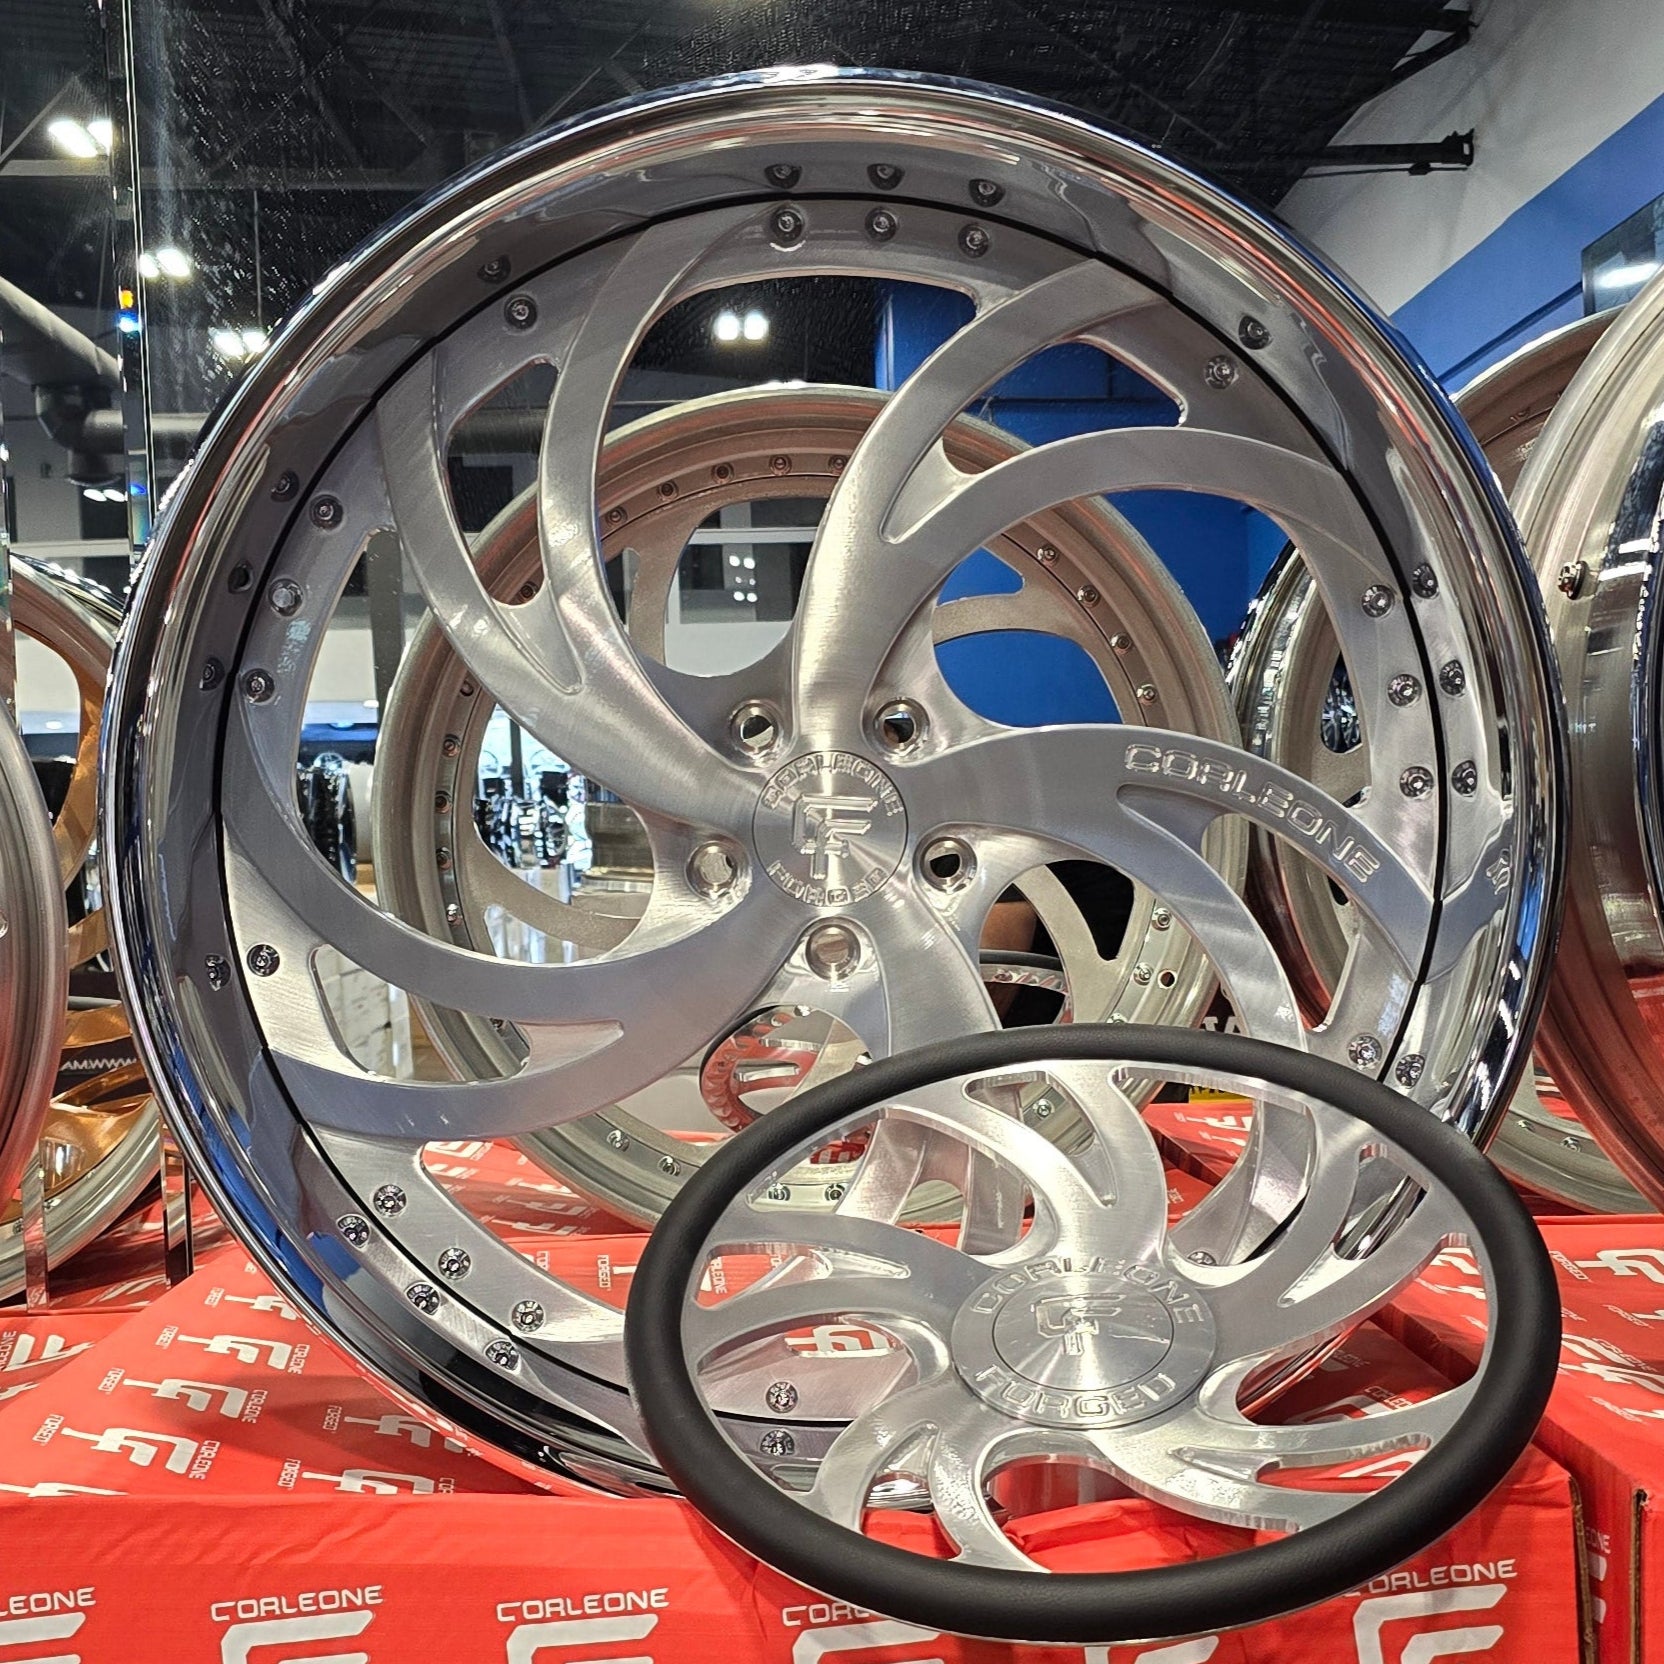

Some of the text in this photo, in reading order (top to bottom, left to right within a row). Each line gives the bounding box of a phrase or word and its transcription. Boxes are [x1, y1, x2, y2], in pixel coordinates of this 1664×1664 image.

[760, 753, 904, 816] CORLEONE
[1124, 743, 1380, 884] CORLEONE
[767, 859, 886, 907] FORGED
[970, 1256, 1204, 1324] CORLEONE
[973, 1363, 1177, 1419] FORGED
[188, 1439, 221, 1480] CORLEONE
[277, 1457, 302, 1488] FORGED
[1345, 1558, 1518, 1598] ORLEONE
[210, 1584, 384, 1622] CORLEONE
[496, 1587, 670, 1622] CORLEONE
